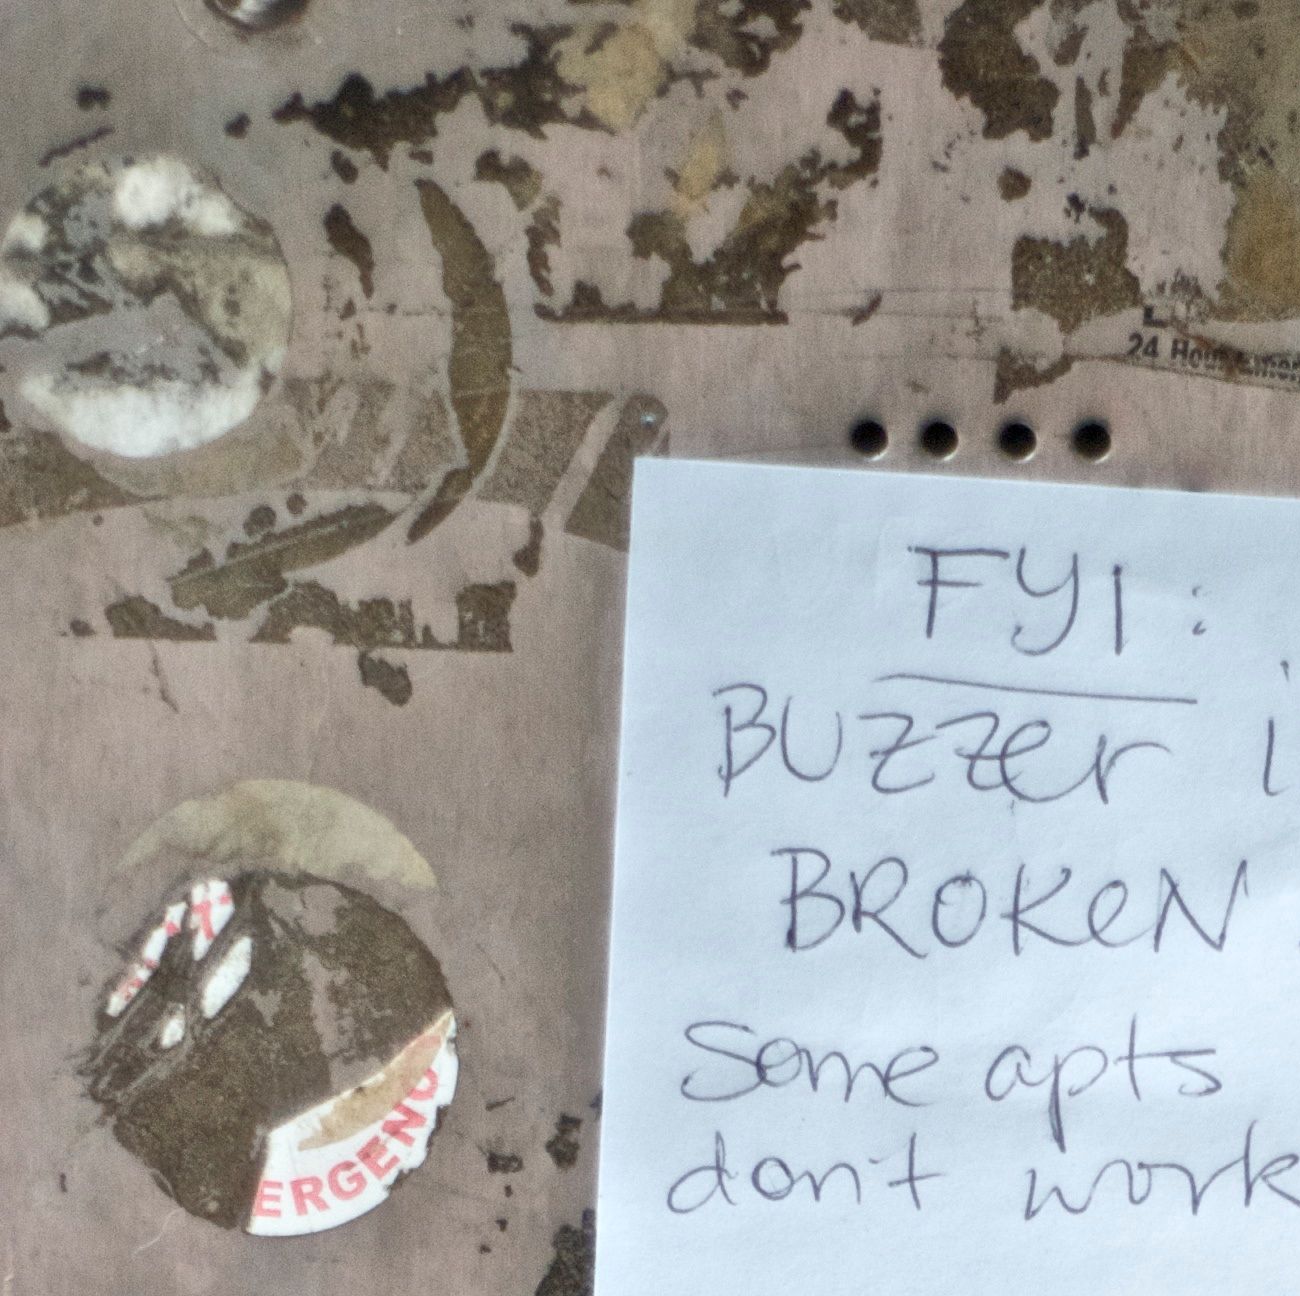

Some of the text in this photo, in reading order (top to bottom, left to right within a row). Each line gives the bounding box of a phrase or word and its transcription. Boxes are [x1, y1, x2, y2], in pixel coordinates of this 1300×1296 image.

[1127, 332, 1160, 358] 24
[907, 545, 1206, 655] FYI:
[983, 1013, 1223, 1152] apts
